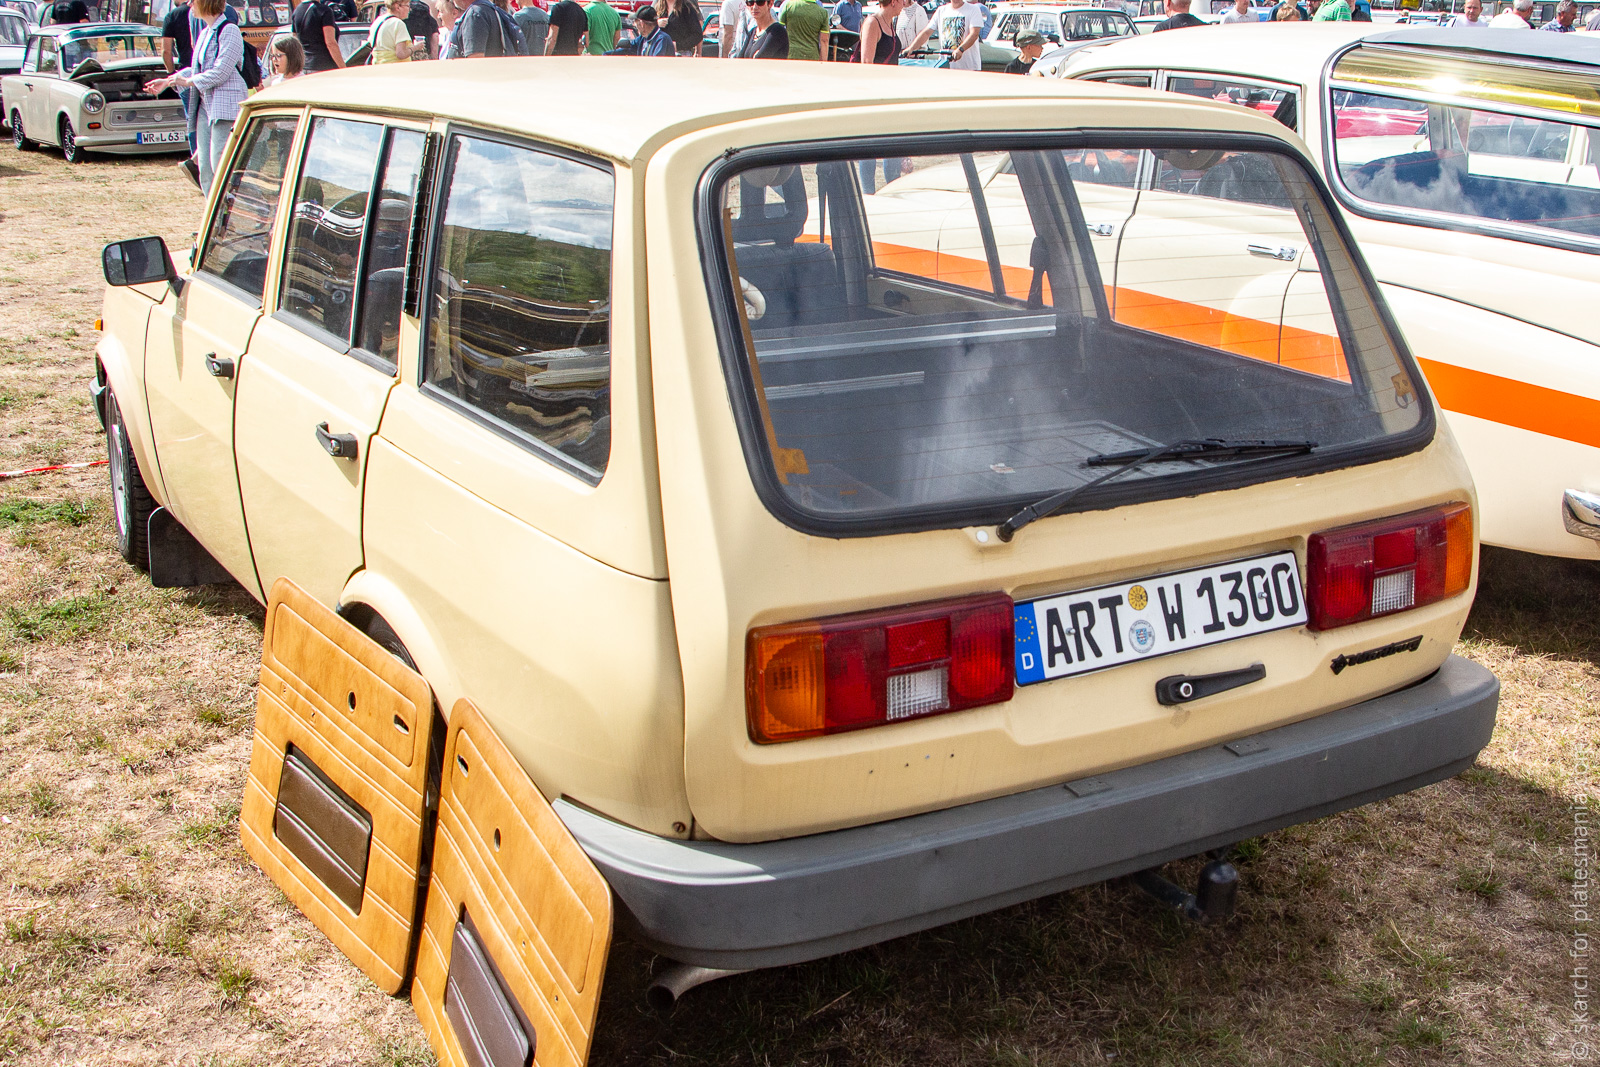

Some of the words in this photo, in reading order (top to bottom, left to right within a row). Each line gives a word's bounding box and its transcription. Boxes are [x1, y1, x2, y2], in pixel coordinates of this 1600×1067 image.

[142, 133, 155, 143] WR
[160, 132, 167, 142] L
[168, 132, 180, 142] 63
[1046, 594, 1125, 669] ART
[1157, 583, 1187, 642] W
[1196, 562, 1301, 634] 1300
[1021, 652, 1035, 670] D
